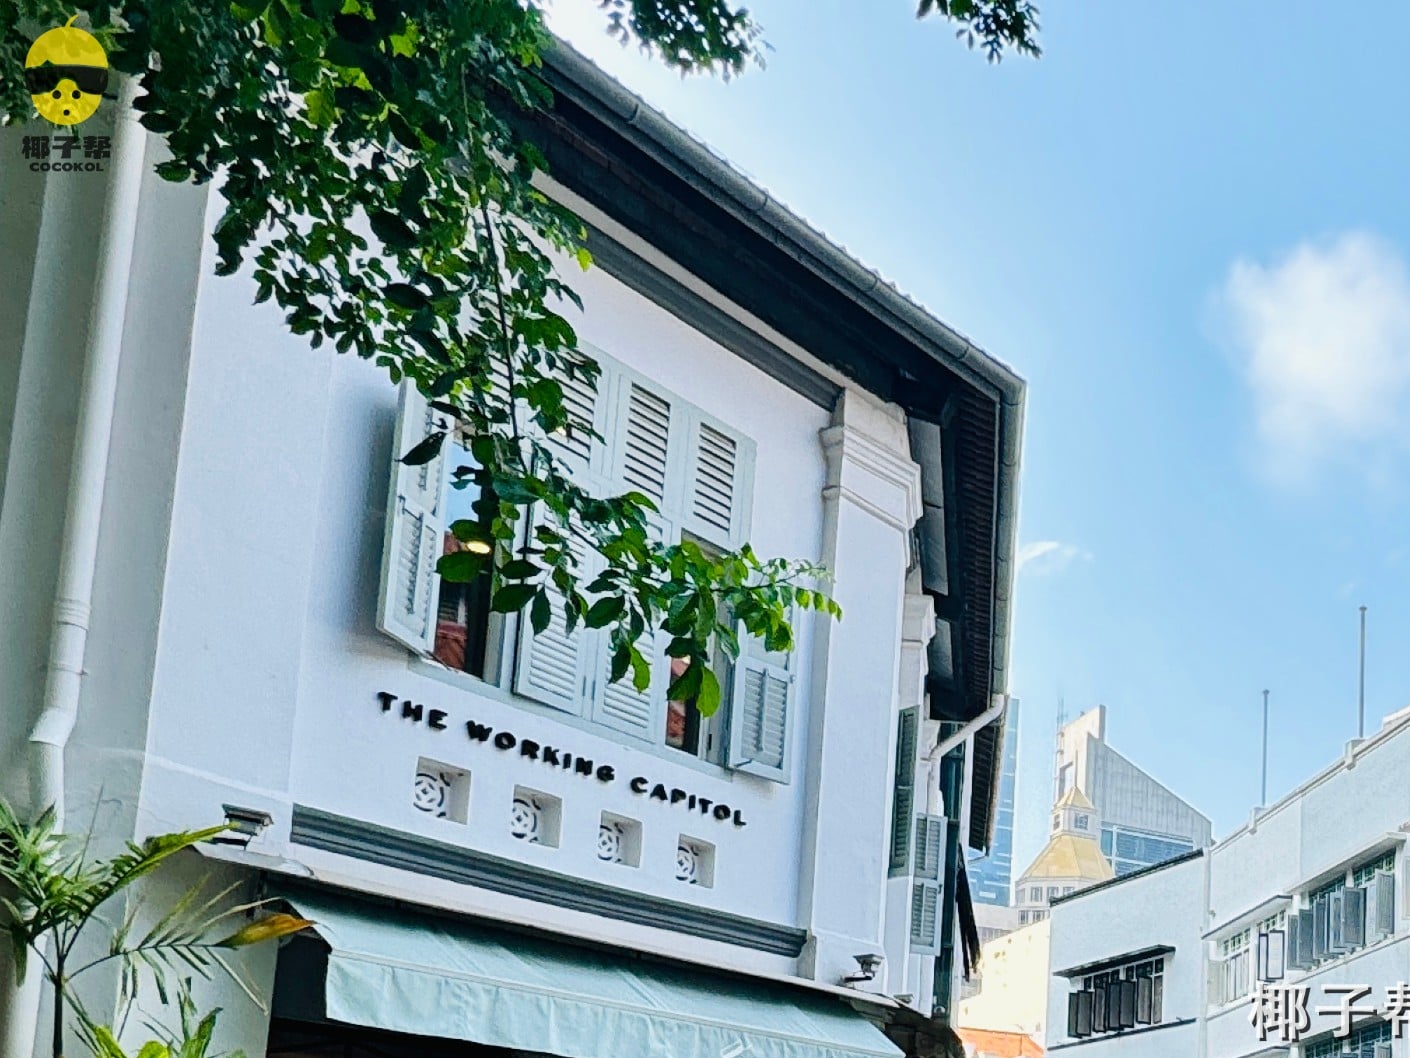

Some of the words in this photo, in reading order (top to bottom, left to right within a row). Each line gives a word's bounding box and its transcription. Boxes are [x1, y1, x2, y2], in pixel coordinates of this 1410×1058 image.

[377, 691, 447, 730] THE
[466, 720, 615, 782] WORKING
[630, 776, 747, 827] CAPITOL
